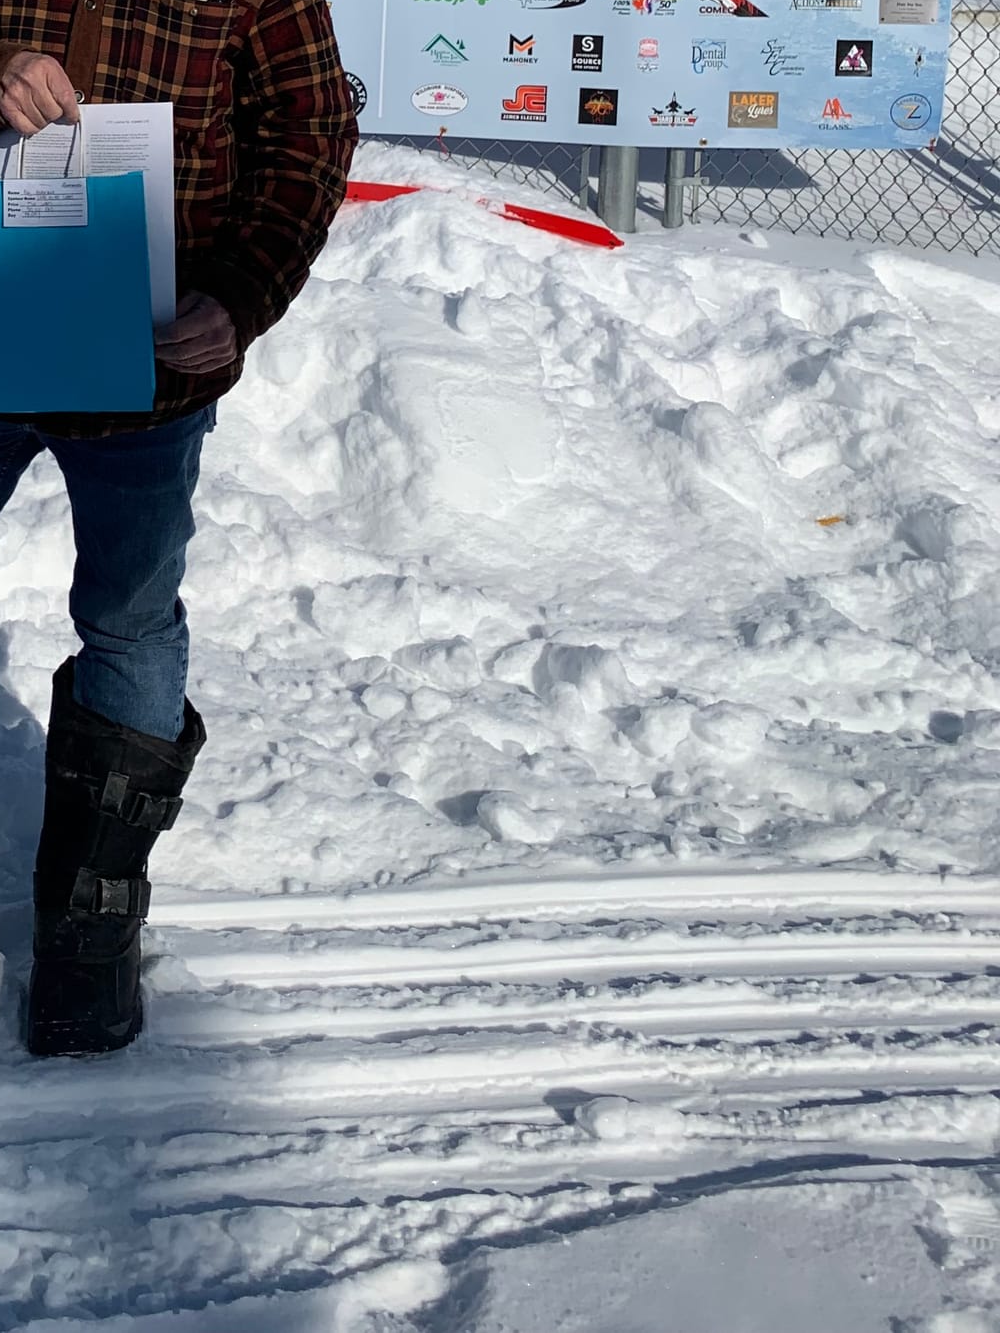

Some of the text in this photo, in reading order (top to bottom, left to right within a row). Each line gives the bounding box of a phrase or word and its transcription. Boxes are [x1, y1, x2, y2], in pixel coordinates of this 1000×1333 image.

[573, 58, 602, 66] SOURCE
[692, 44, 728, 64] Dental
[693, 59, 729, 75] Group
[346, 73, 367, 104] MEATS
[731, 94, 775, 107] LAKER
[748, 103, 774, 119] Lures
